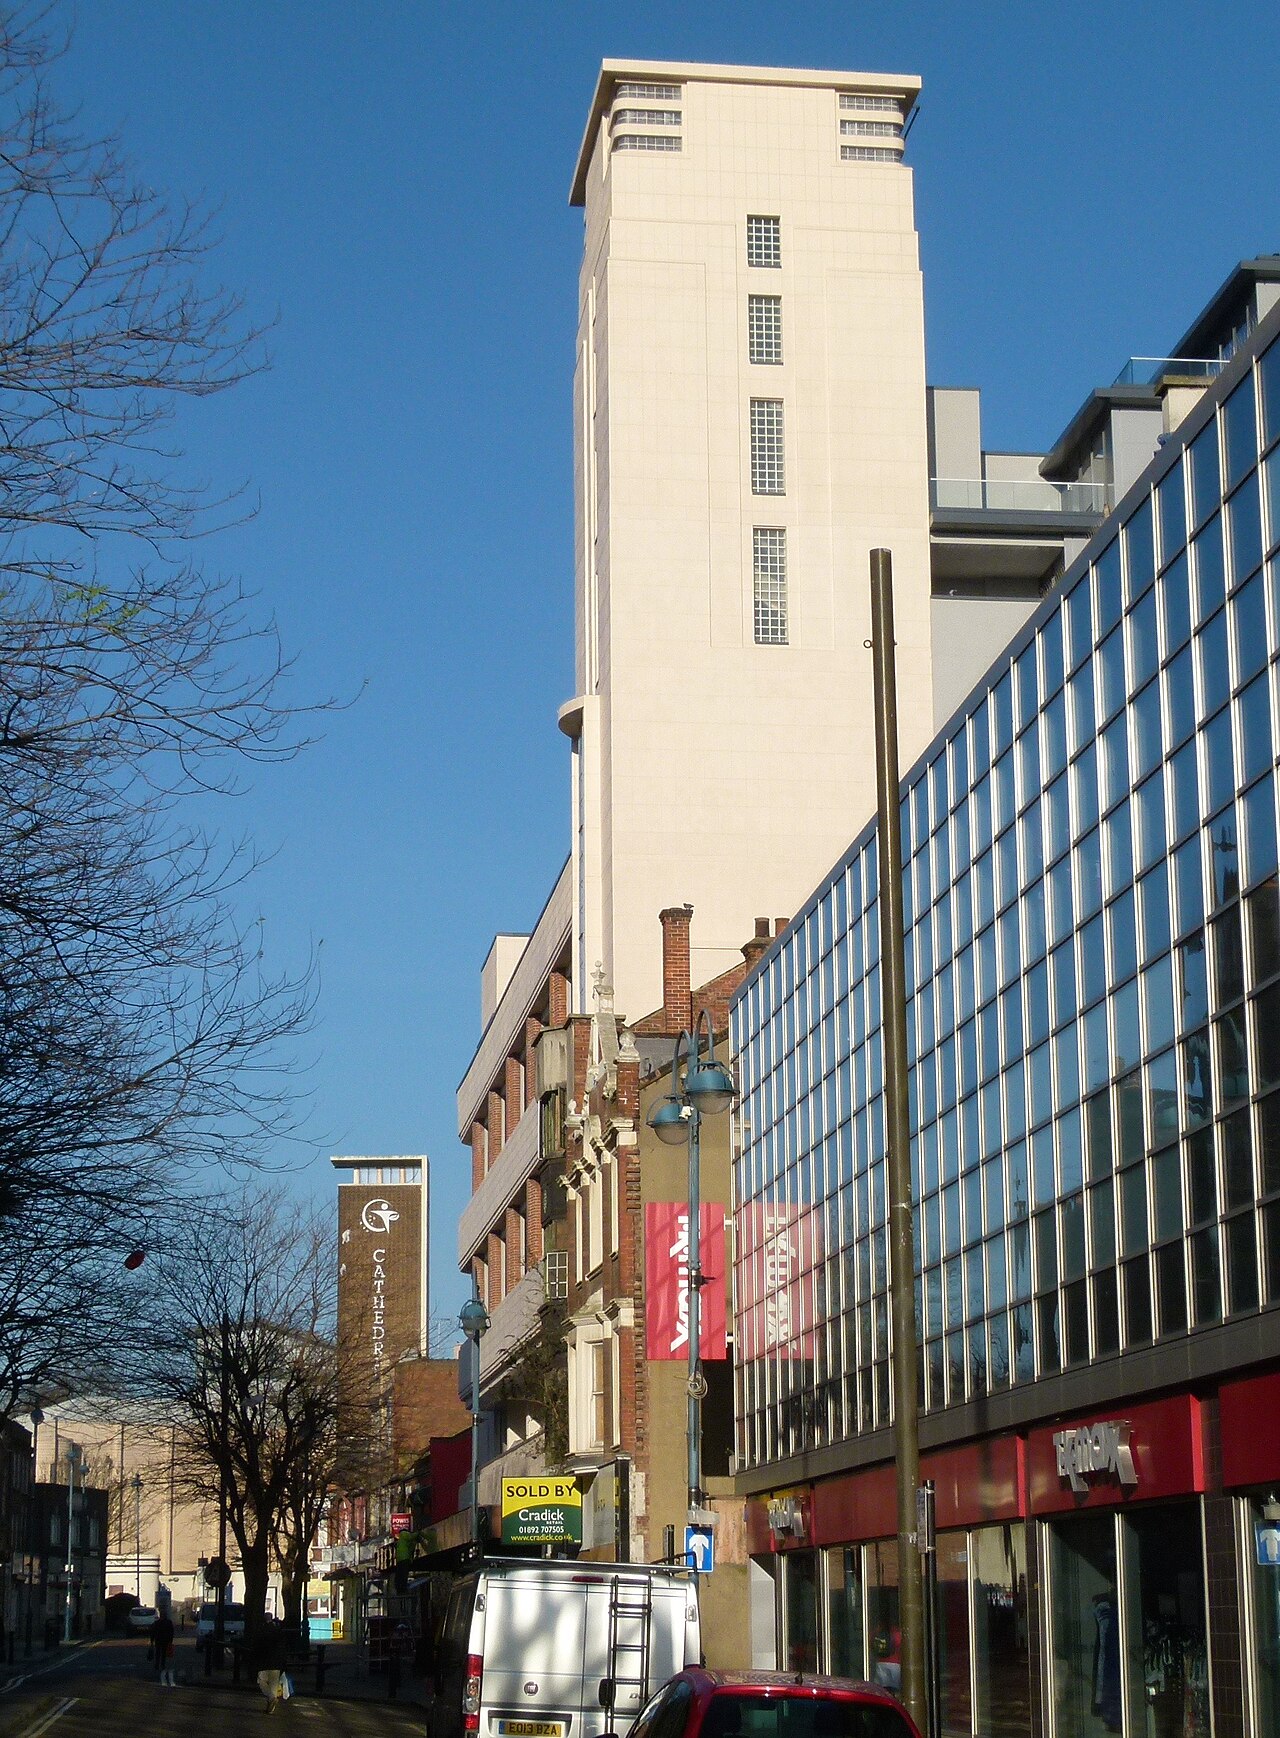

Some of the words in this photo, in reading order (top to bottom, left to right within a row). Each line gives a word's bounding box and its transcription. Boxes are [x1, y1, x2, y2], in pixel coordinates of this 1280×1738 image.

[372, 1249, 386, 1378] CATHEDR
[506, 1485, 550, 1498] SOLD
[555, 1485, 574, 1497] BY
[518, 1508, 564, 1520] Cradick
[518, 1526, 540, 1534] 01892
[540, 1525, 565, 1533] 707505
